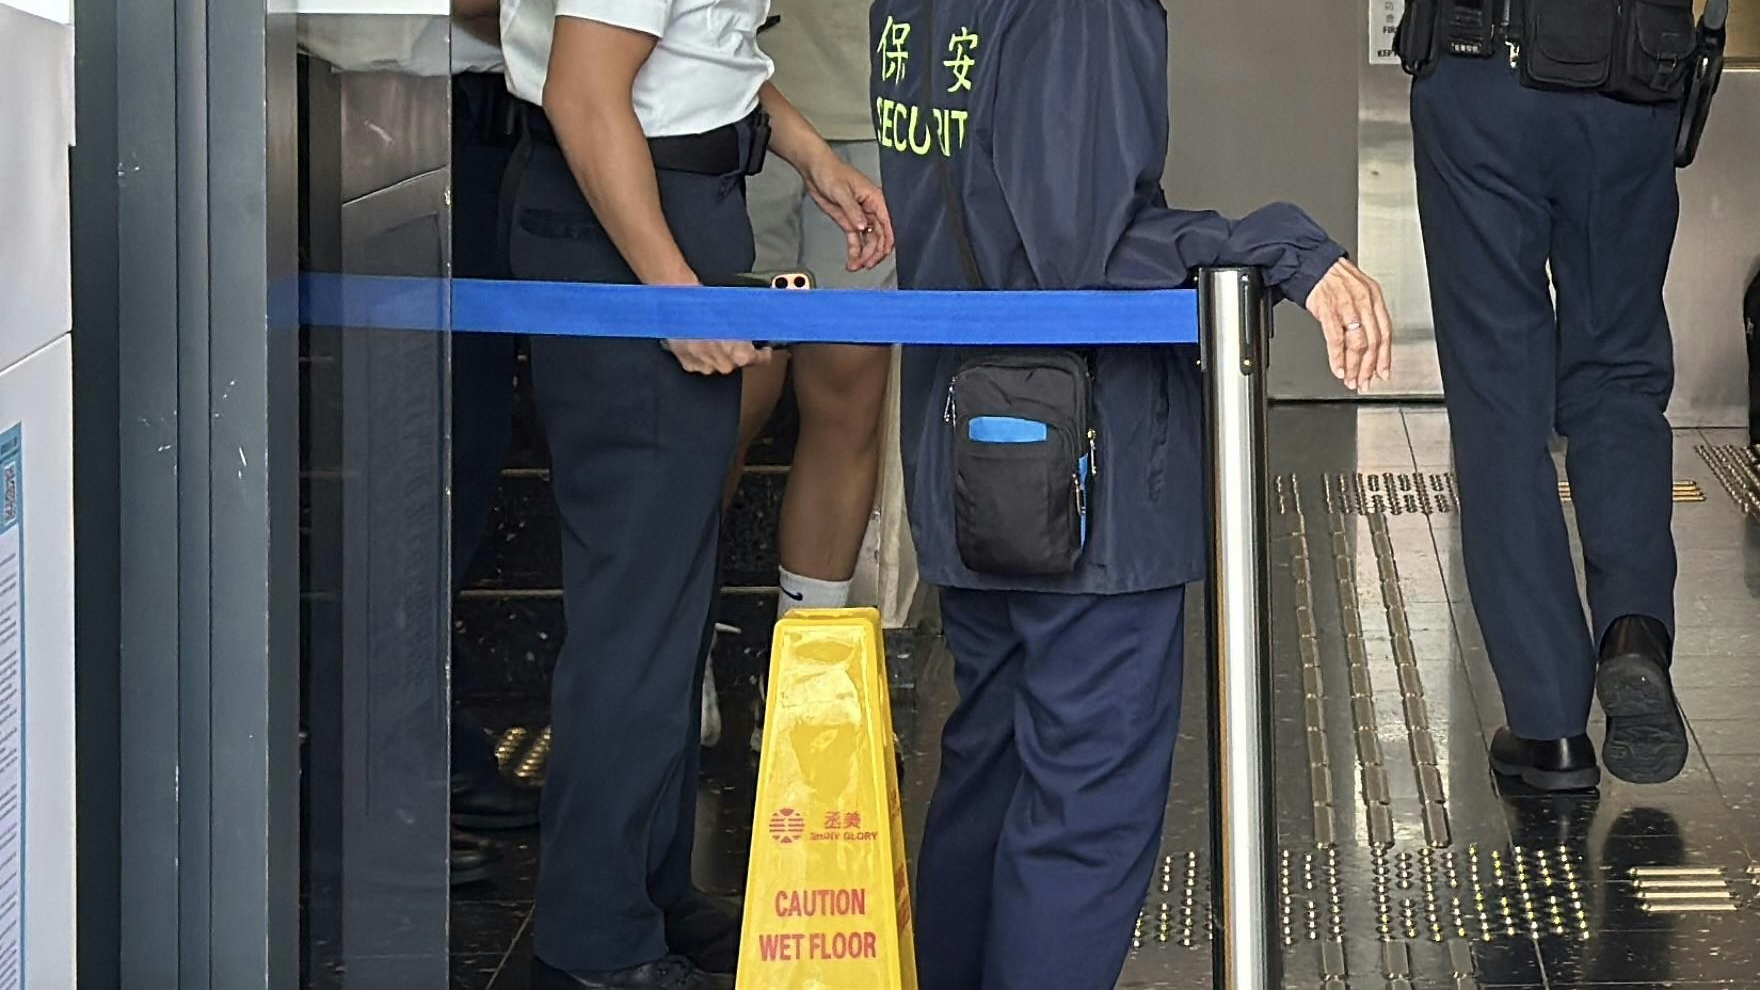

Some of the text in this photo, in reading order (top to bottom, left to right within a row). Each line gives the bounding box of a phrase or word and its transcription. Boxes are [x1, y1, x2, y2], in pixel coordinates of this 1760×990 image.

[877, 96, 968, 156] SECUIT
[844, 832, 878, 841] GLORY
[775, 888, 866, 917] CAUTION
[759, 931, 876, 962] WET FLOOR
